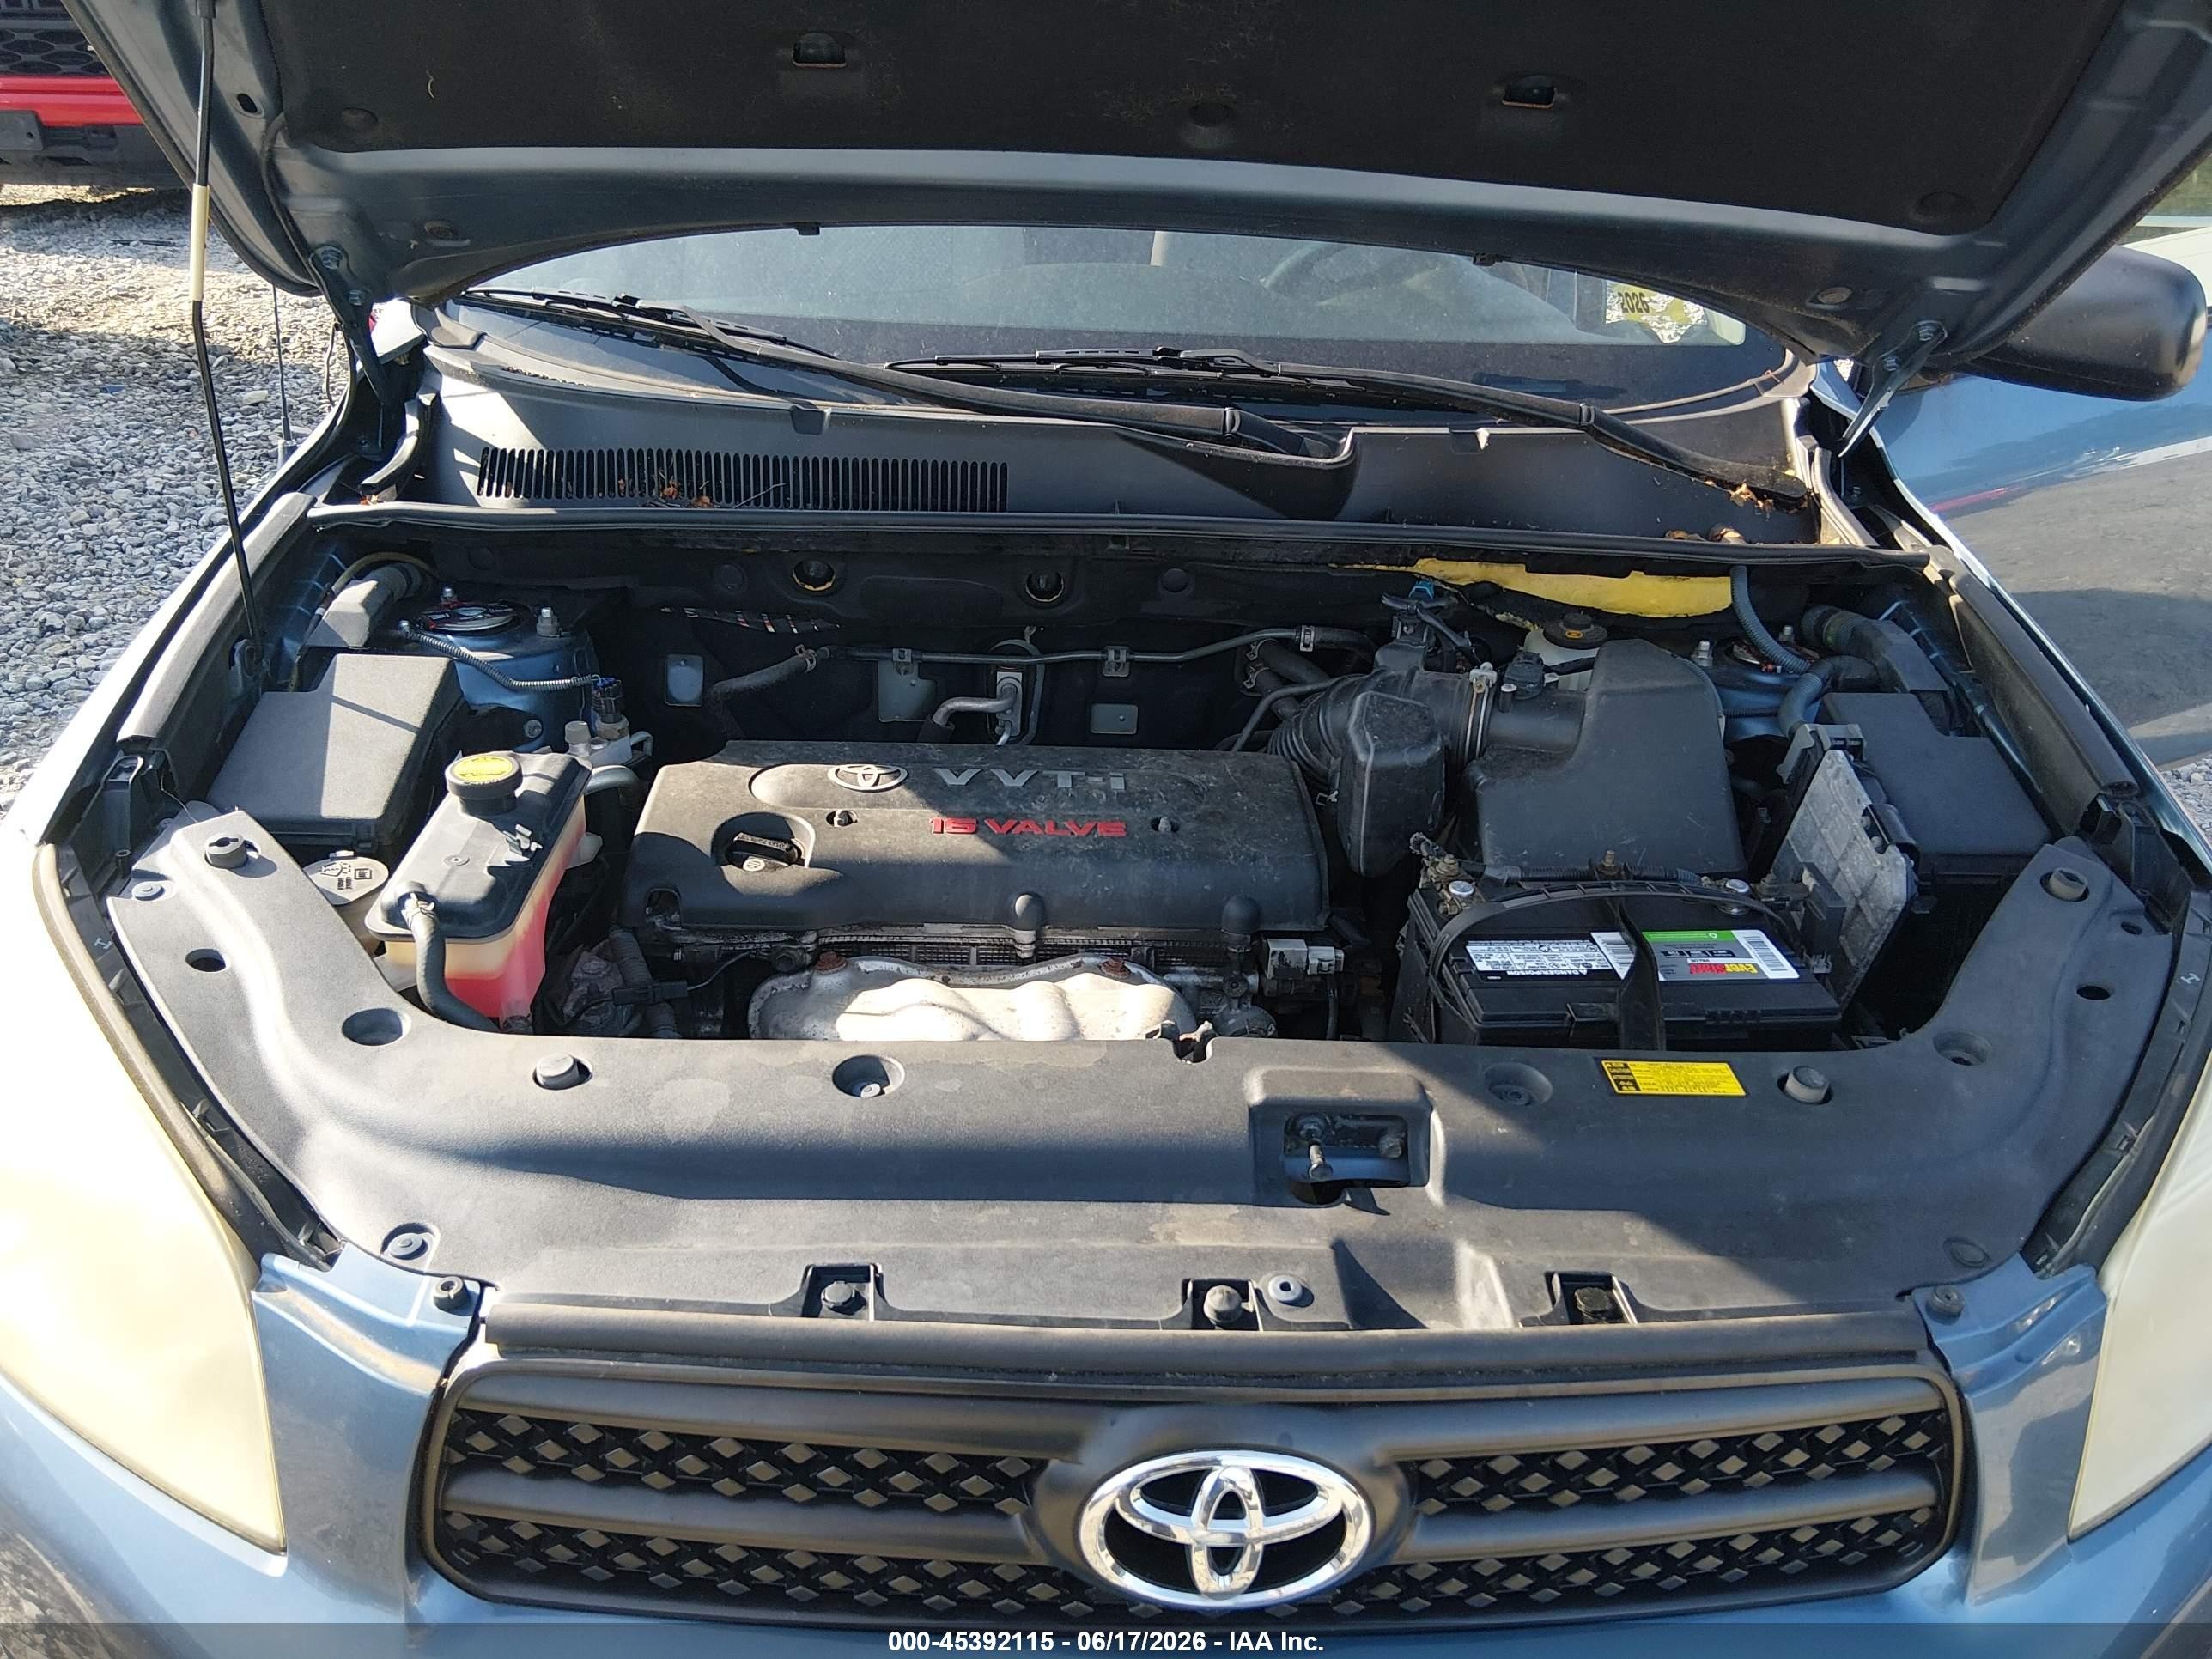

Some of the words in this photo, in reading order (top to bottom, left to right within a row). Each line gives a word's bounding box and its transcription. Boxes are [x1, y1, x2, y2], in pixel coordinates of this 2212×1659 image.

[1618, 291, 1650, 313] 2026
[934, 768, 1125, 791] VVT-i
[929, 817, 977, 834] 16
[984, 818, 1127, 836] VALVE
